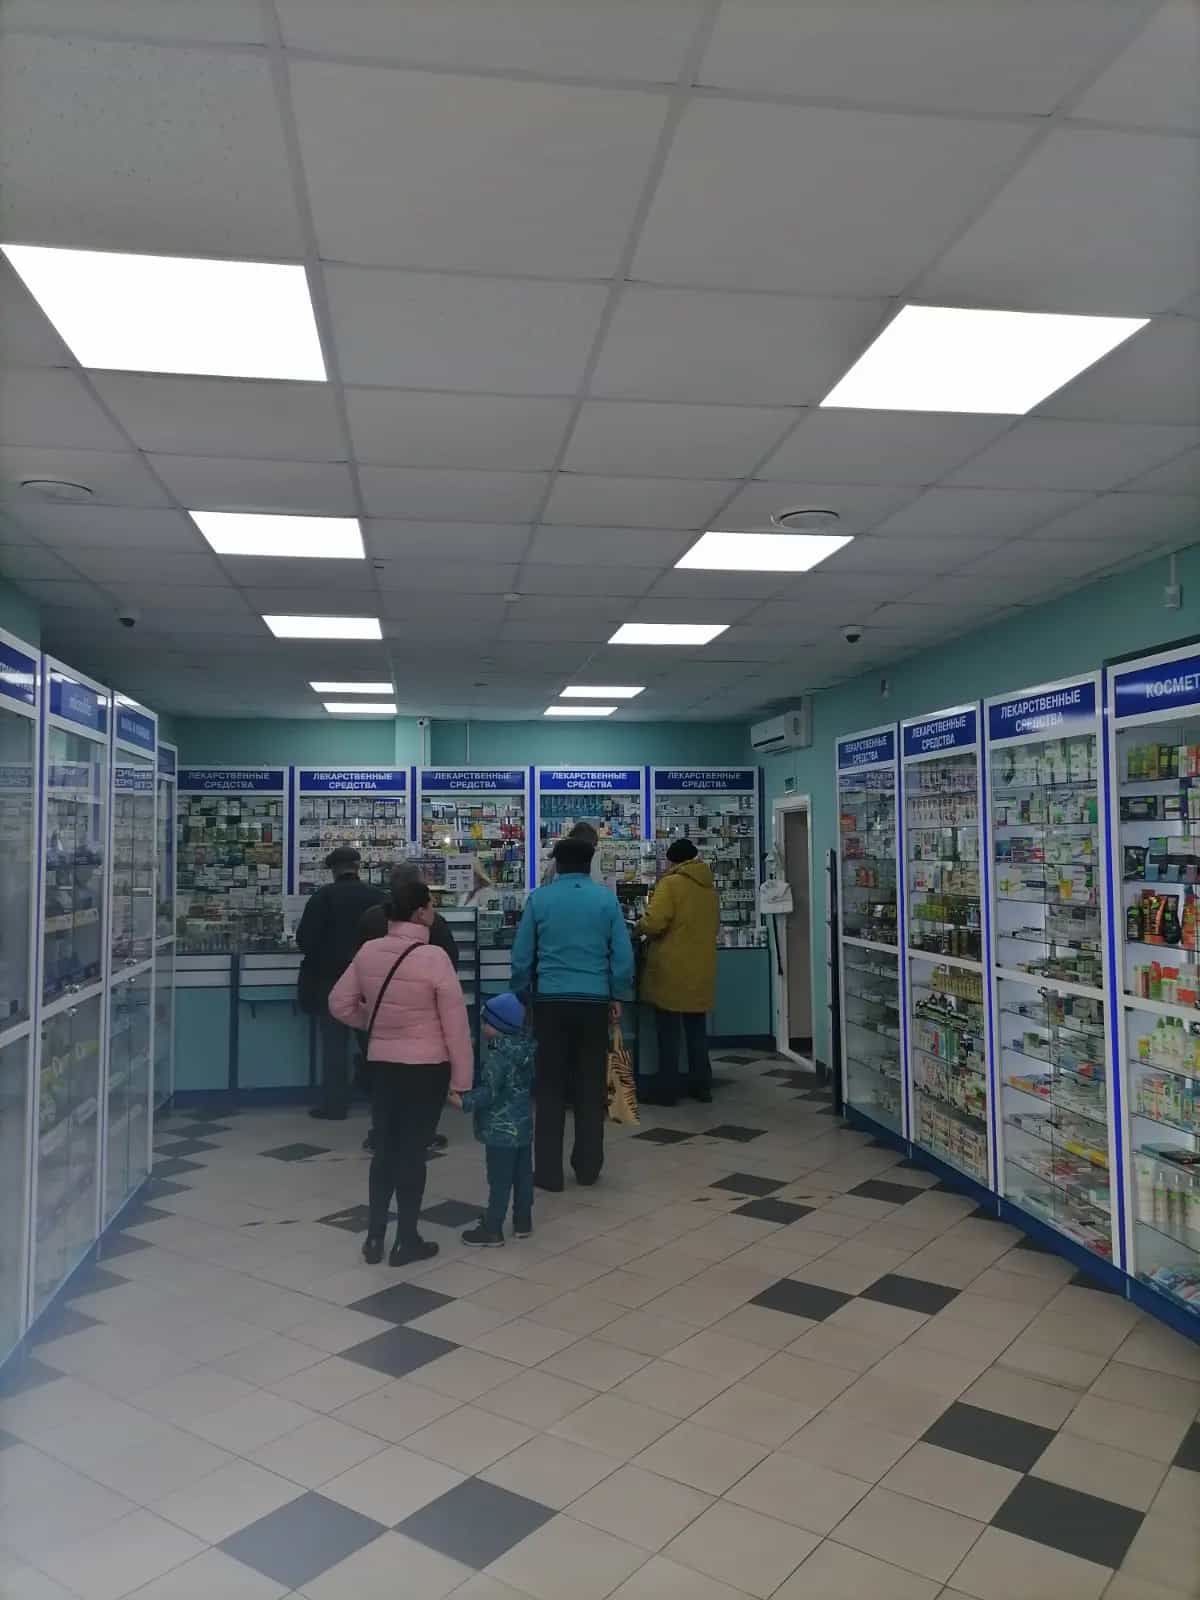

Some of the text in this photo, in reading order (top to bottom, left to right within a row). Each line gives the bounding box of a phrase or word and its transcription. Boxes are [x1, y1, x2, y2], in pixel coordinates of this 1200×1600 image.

[1000, 689, 1081, 719] ЛЕКАРСТВЕННЫЕ
[911, 716, 967, 739] ЛЕКАРСТВЕННЫЕ
[845, 735, 887, 753] ЛЕКАРСТВЕННЫЕ
[921, 734, 956, 751] СРЕДСТВА
[189, 773, 270, 781] ЛЕКАРСТВЕННЫЕ
[313, 773, 393, 781] ЛЕКАРСТВЕННЫЕ
[434, 773, 512, 781] ЛЕКАРСТВЕННЫЕ
[552, 773, 628, 781] ЛЕКАРСТВЕННЫЕ
[667, 773, 742, 781] ЛЕКАРСТВЕННЫЕ
[204, 780, 254, 789] СРЕДСТВА
[328, 780, 377, 789] СРЕДСТВА
[449, 780, 497, 789] СРЕДСТВА
[567, 780, 613, 789] СРЕДСТВА
[682, 780, 727, 789] СРЕДСТВА
